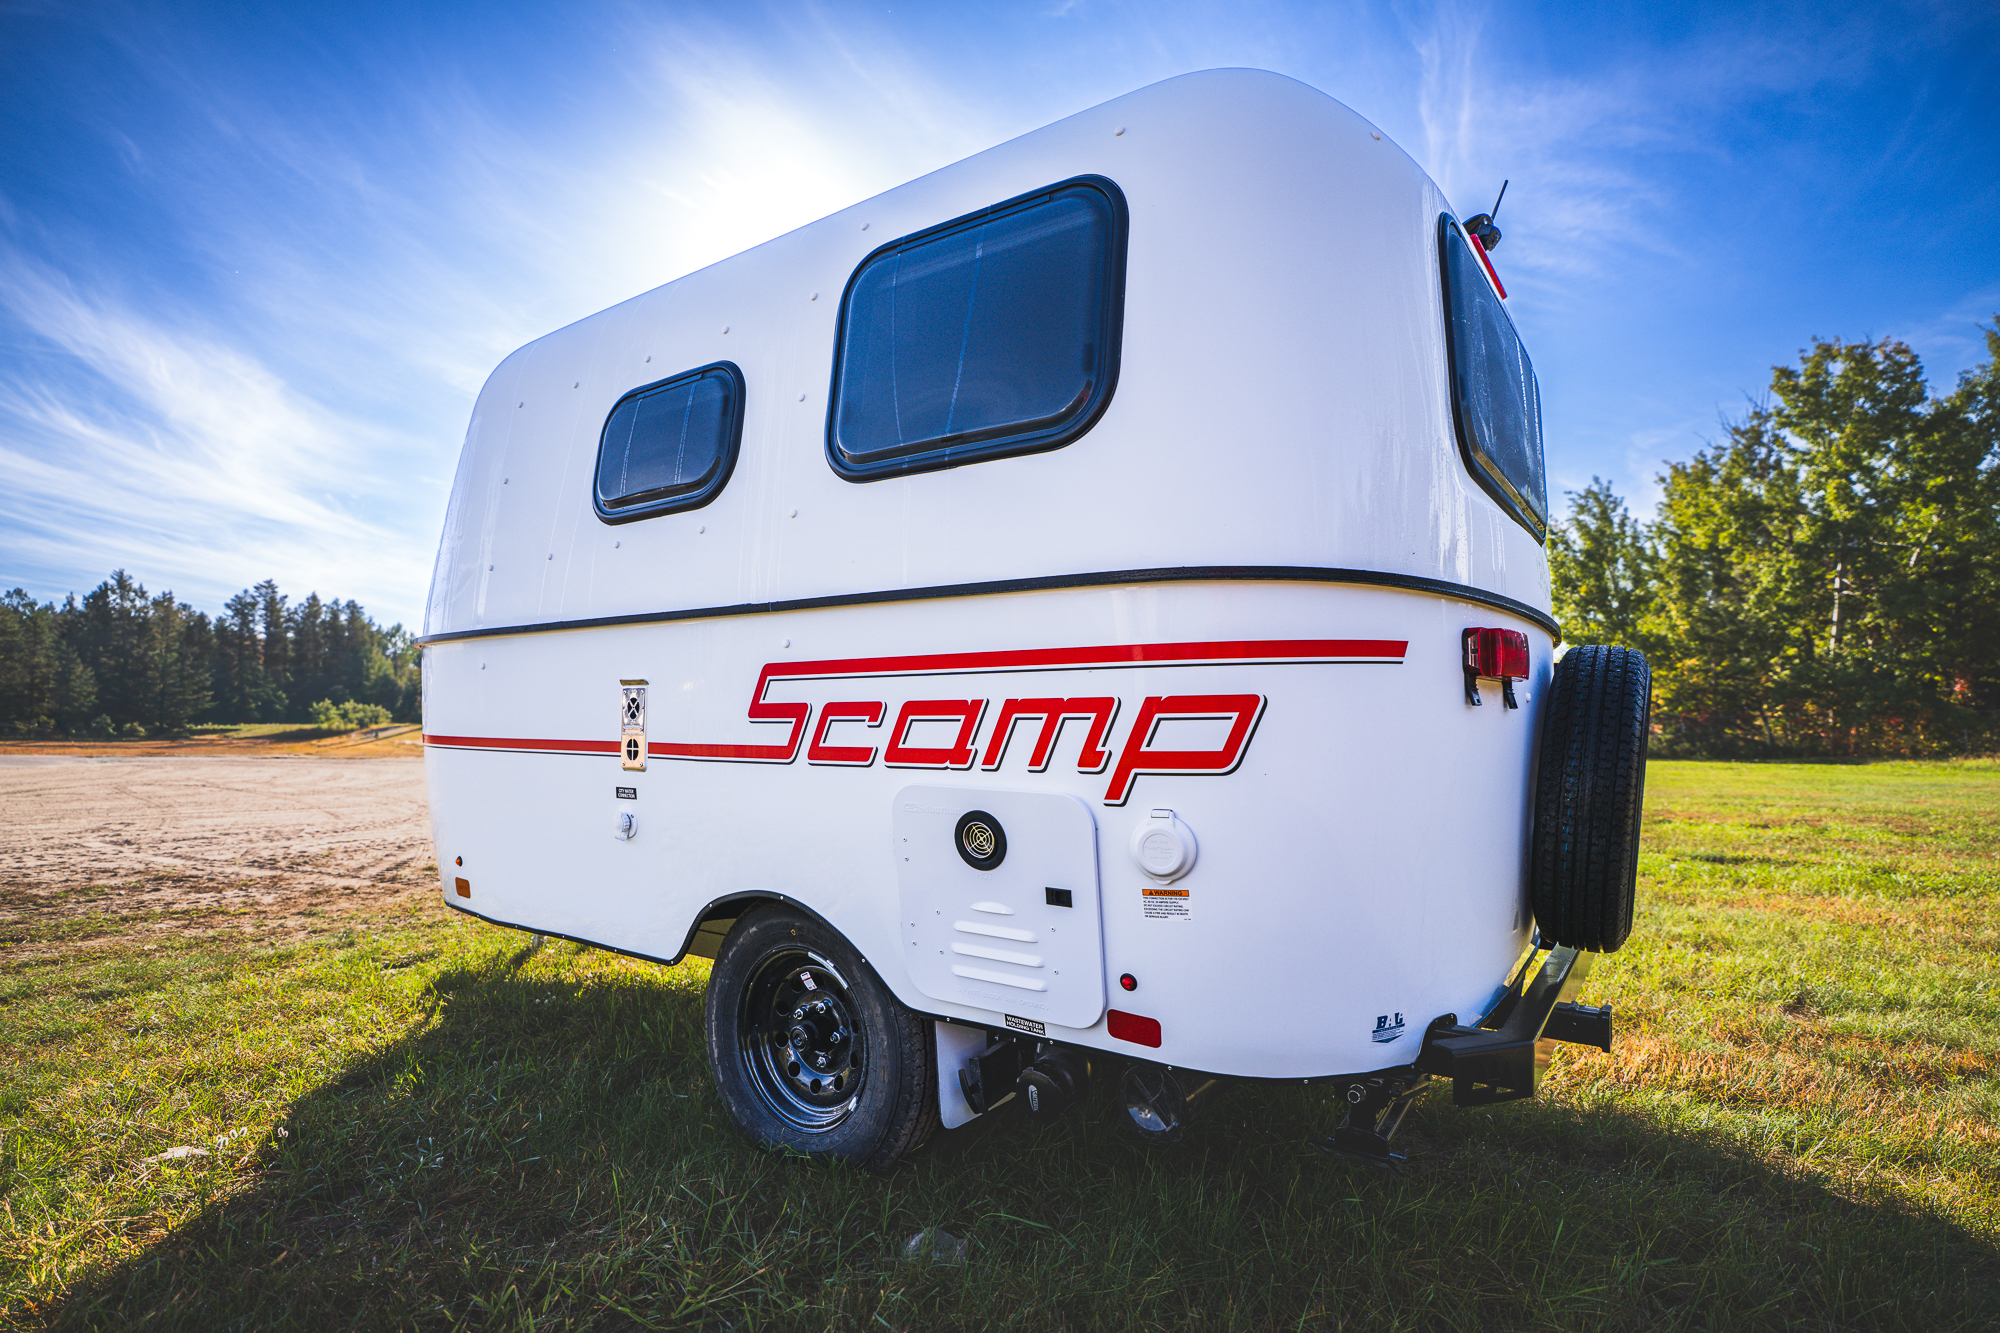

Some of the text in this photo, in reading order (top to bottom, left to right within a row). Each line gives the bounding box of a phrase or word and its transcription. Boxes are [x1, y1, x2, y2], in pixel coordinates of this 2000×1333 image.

[747, 661, 1268, 808] Scamp
[918, 803, 961, 816] Suburban
[976, 871, 993, 881] HOT
[967, 988, 979, 996] NOT
[1020, 998, 1050, 1011] OPENINGS
[1006, 1015, 1044, 1030] WASTEWATER
[1006, 1020, 1045, 1035] HOLDING TANK
